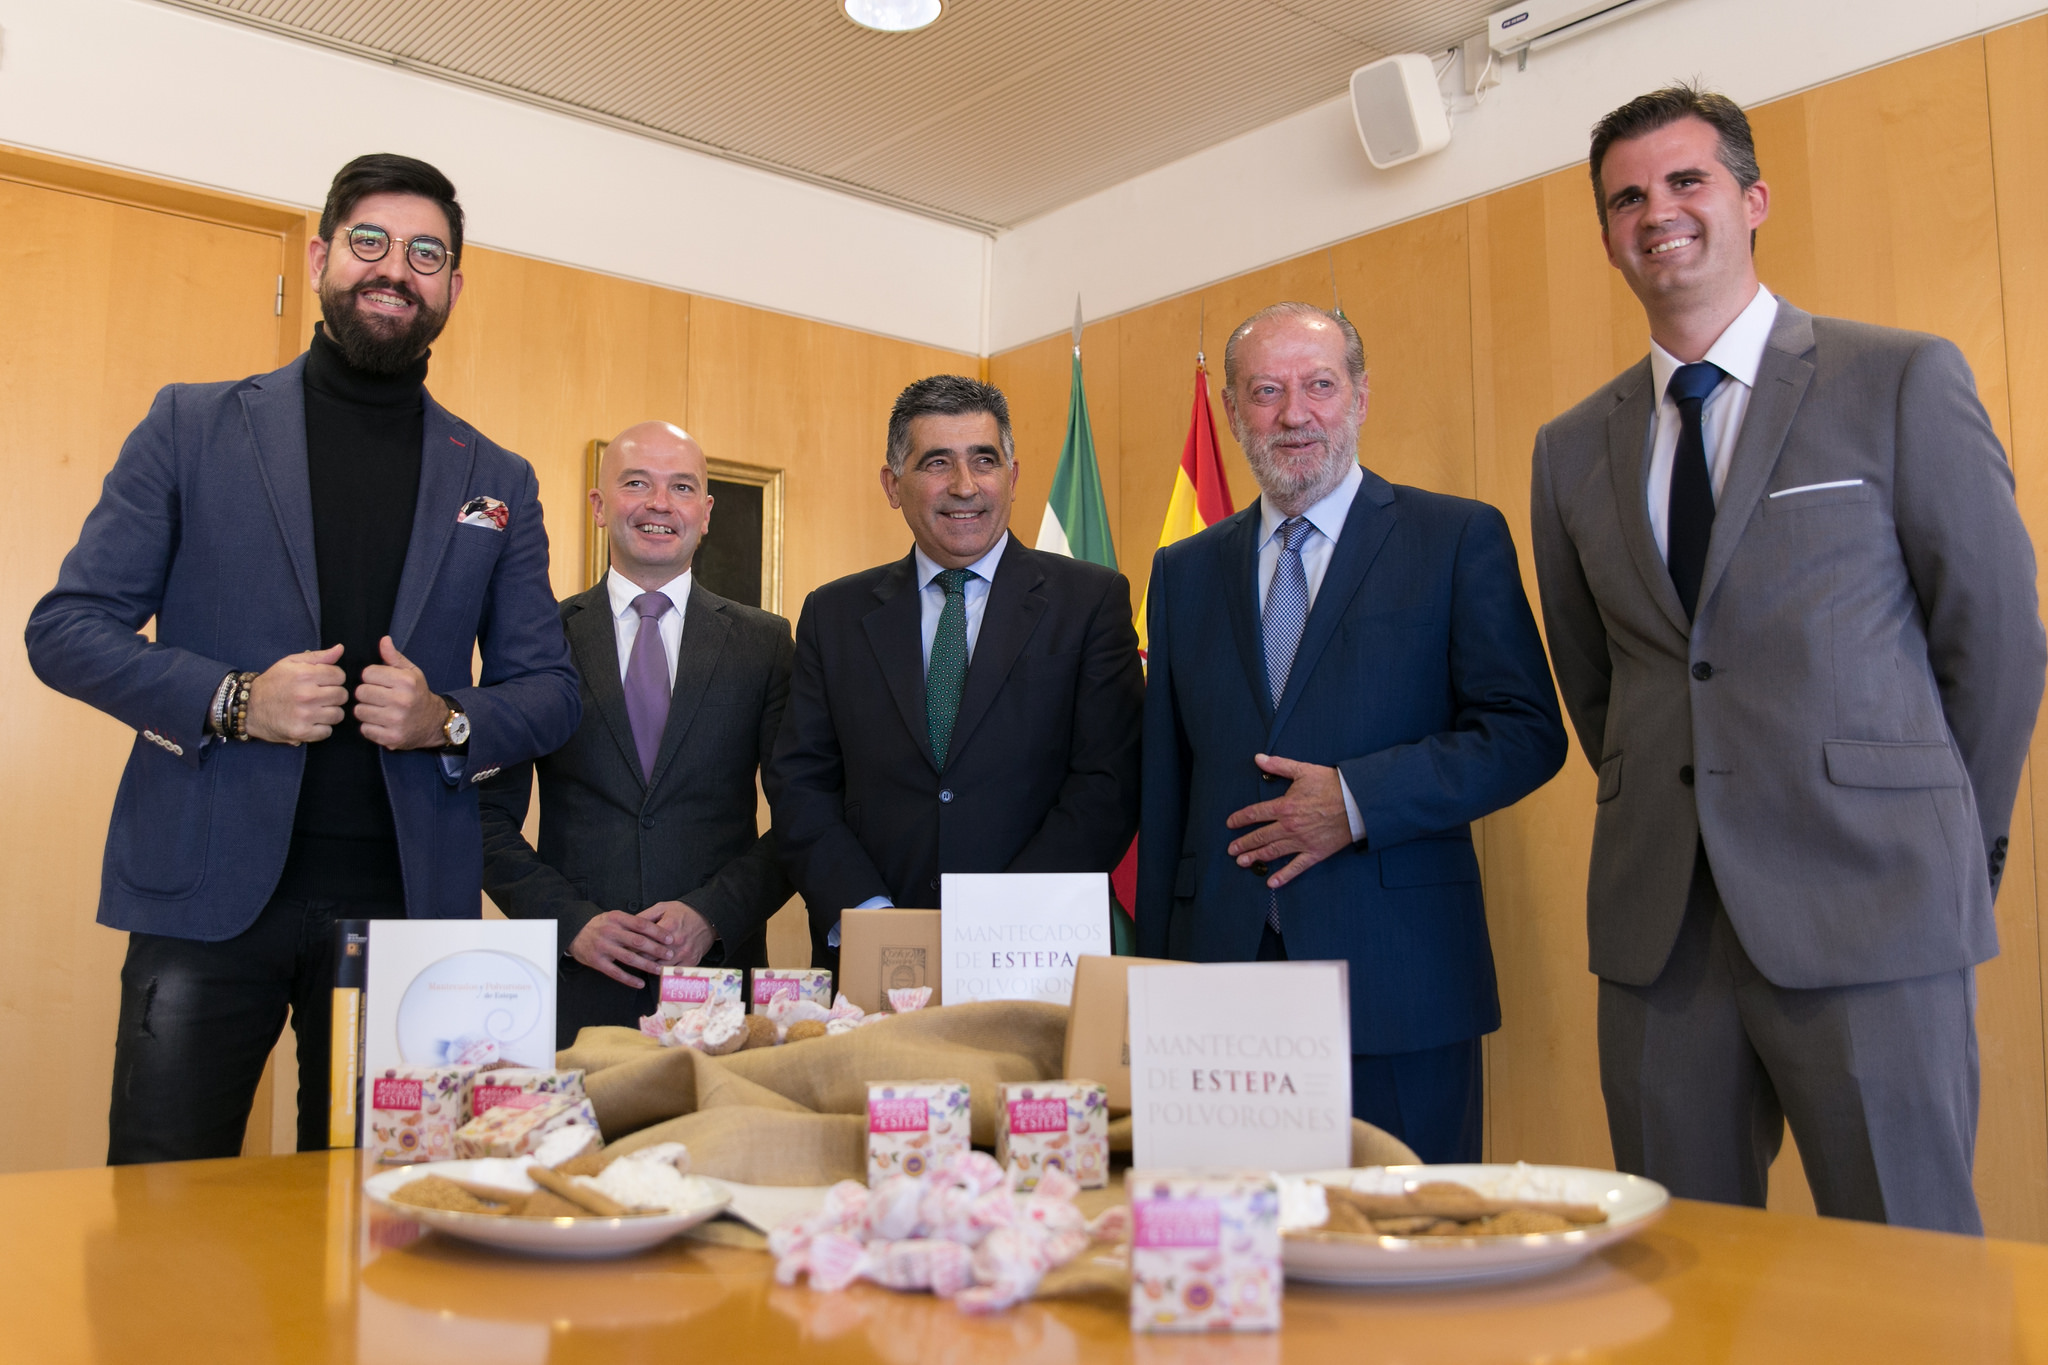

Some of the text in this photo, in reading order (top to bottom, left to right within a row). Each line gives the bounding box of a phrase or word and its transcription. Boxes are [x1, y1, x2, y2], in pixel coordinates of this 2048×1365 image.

[954, 923, 1102, 942] MANTECADOS
[955, 951, 1074, 969] DE ESTEPA
[428, 981, 479, 991] Mantecados
[485, 981, 532, 991] Polvorones
[956, 976, 1073, 995] POLVORON
[494, 992, 518, 1001] Estepa
[671, 990, 707, 999] ESTEPA
[1145, 1033, 1332, 1059] MANTECADOS
[1147, 1067, 1297, 1095] DE ESTEPA
[381, 1095, 421, 1106] ESTEPA
[880, 1115, 927, 1129] ESTEPA
[1020, 1115, 1066, 1130] ESTEPA
[1149, 1102, 1336, 1132] POLVORONES
